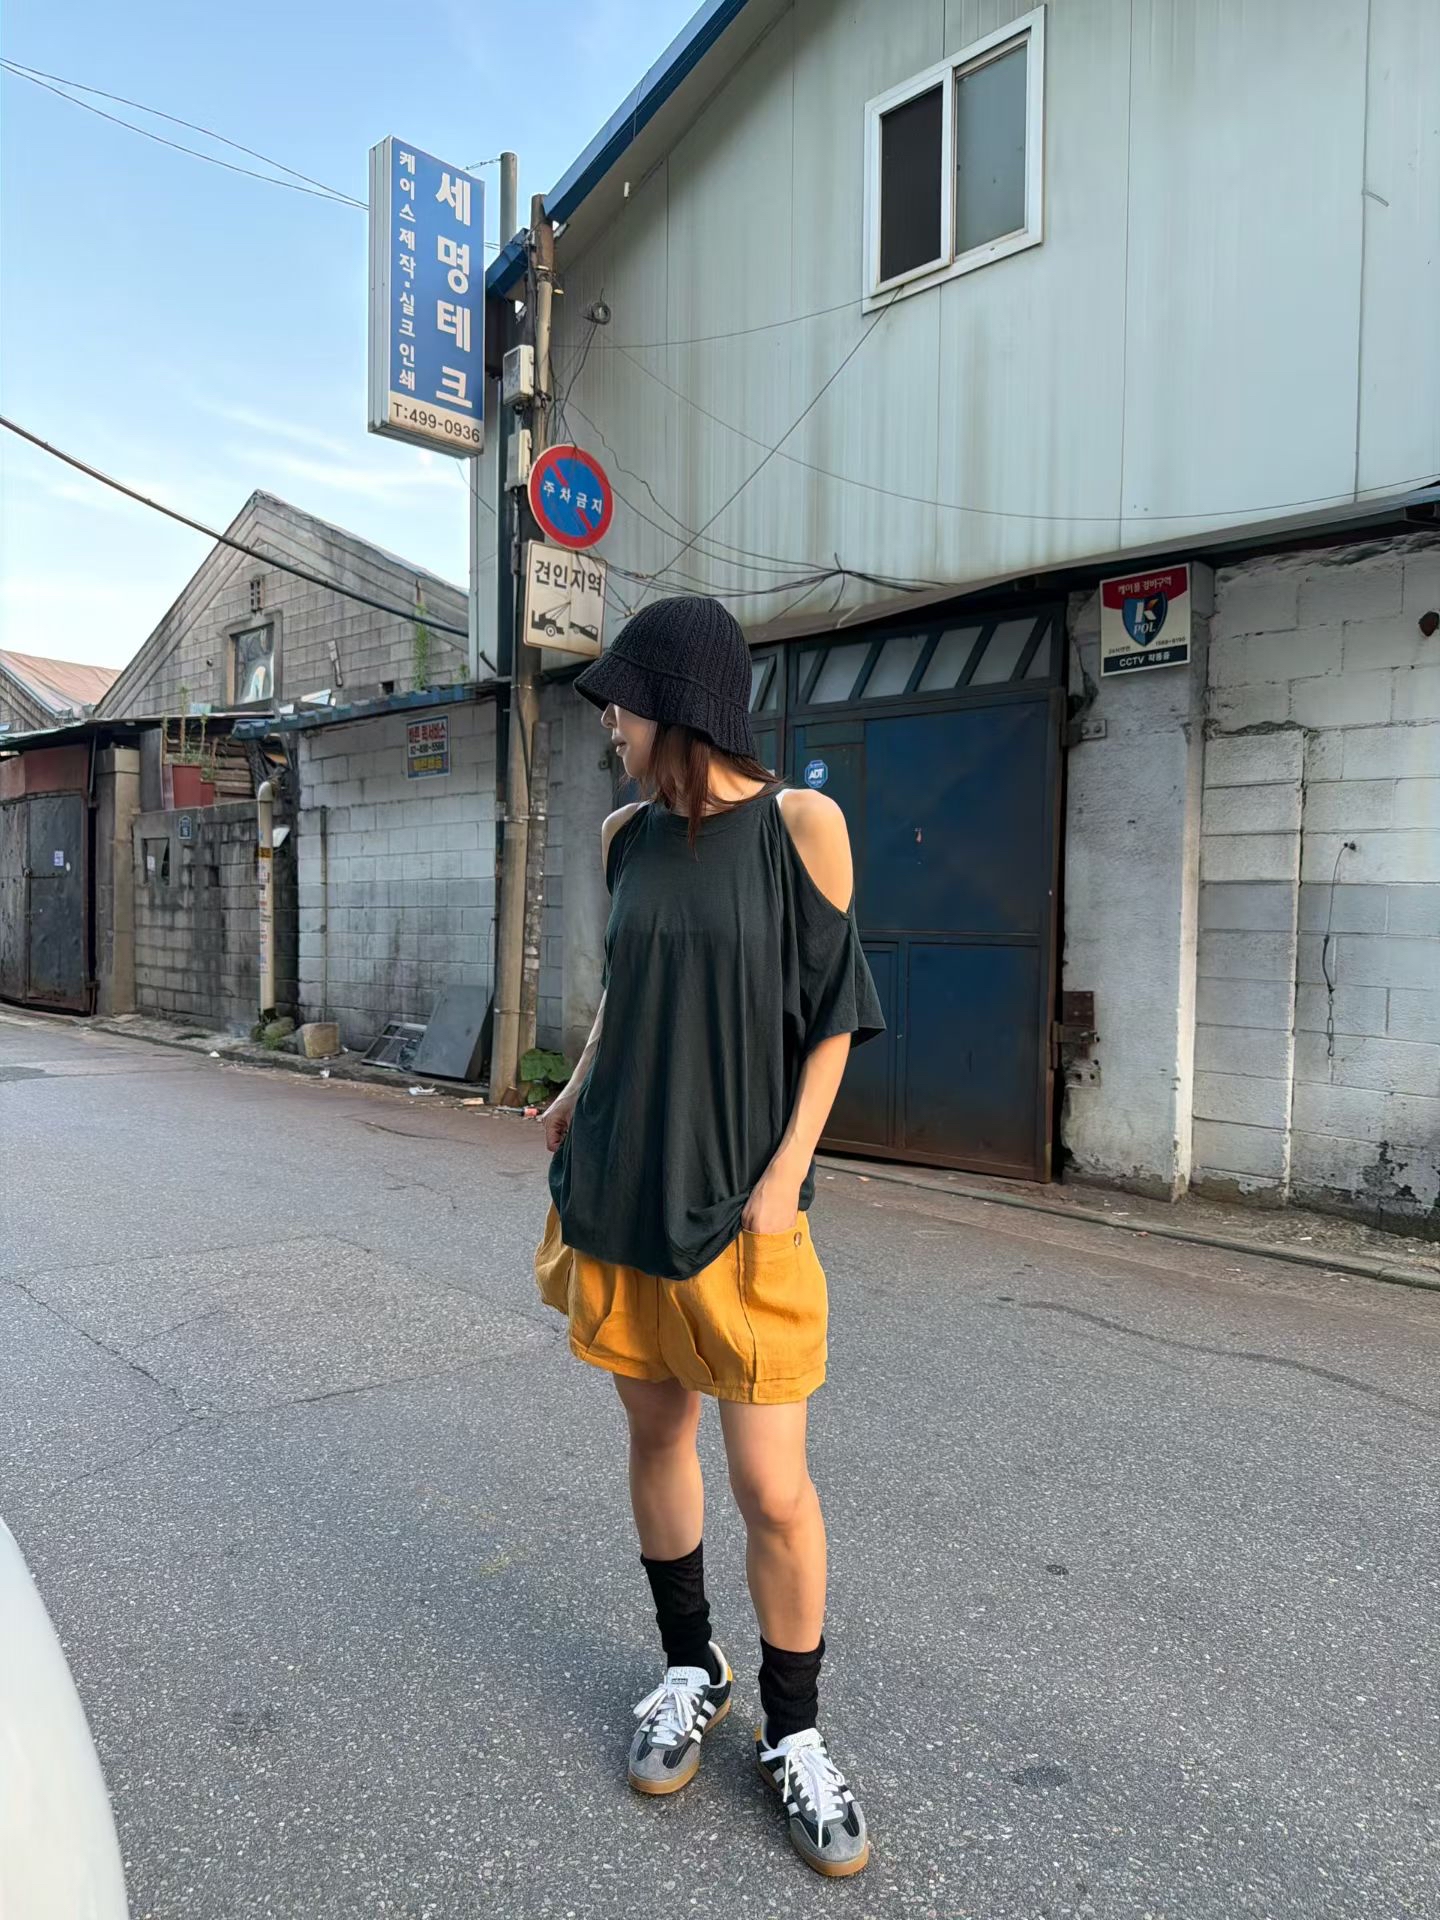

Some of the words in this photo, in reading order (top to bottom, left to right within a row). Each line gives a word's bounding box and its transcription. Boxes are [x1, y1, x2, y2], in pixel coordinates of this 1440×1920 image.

[435, 172, 472, 408] 세명테크
[393, 402, 480, 443] T:499-0936
[544, 481, 602, 514] 주차금지
[535, 560, 601, 596] 견인지역
[1133, 622, 1156, 636] POL
[1119, 656, 1144, 667] CCTV
[808, 768, 824, 779] ADT
